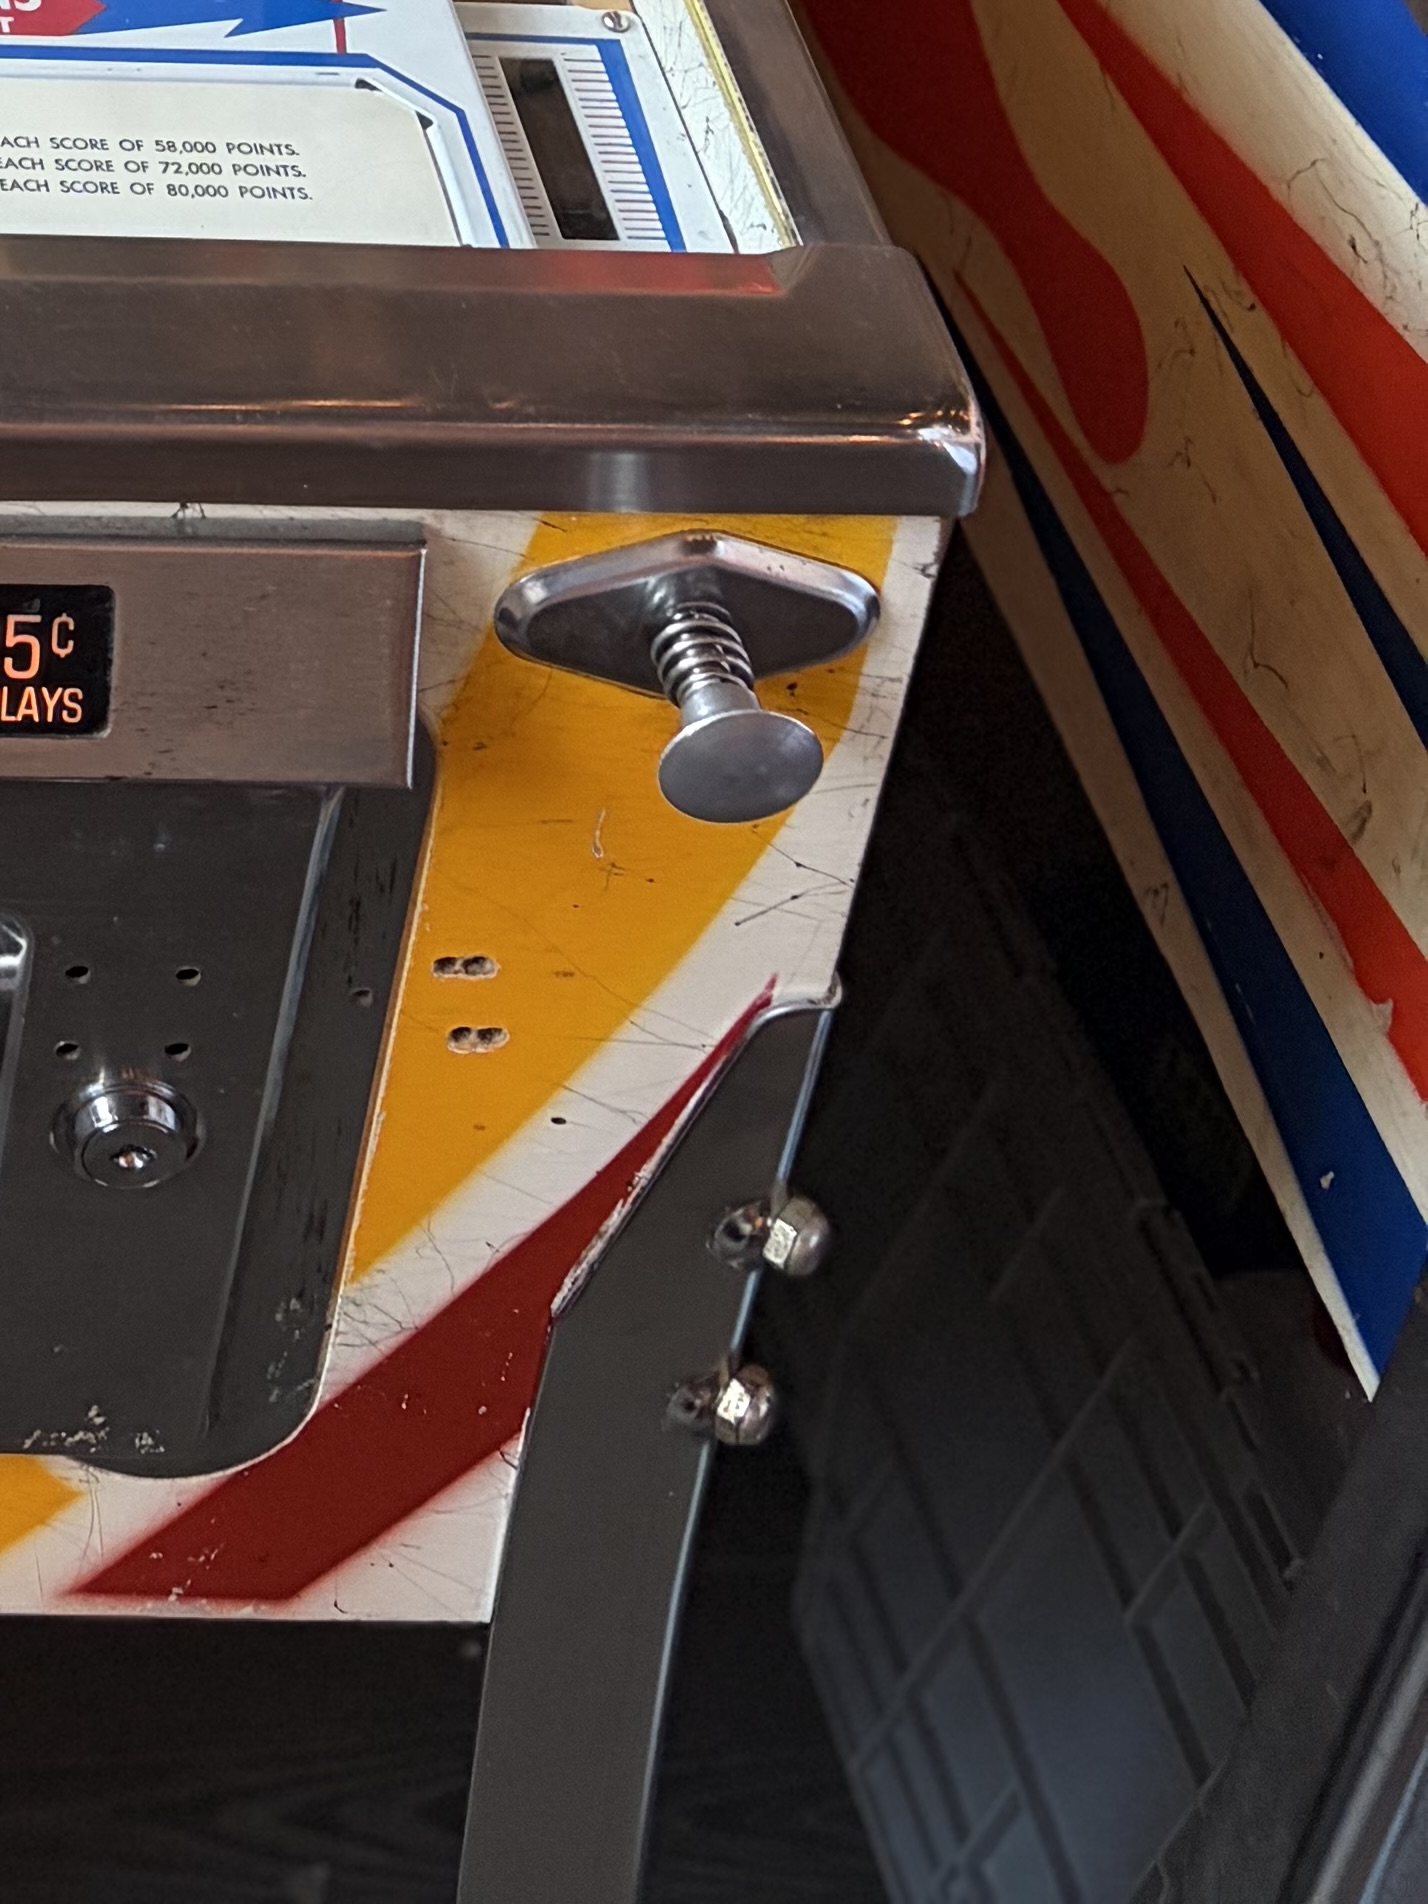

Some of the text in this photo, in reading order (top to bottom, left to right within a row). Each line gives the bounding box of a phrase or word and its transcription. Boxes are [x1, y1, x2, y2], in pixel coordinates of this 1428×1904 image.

[49, 137, 110, 151] SCORE
[119, 138, 145, 152] OF
[154, 139, 217, 155] 58,000
[226, 142, 301, 157] POINTS.
[54, 158, 115, 173] SCORE
[124, 159, 150, 174] OF
[158, 160, 223, 177] 72,000
[232, 163, 307, 179] POINTS.
[0, 179, 50, 193] EACH
[60, 181, 120, 195] SCORE
[129, 182, 155, 195] OF
[166, 183, 229, 199] 80,000
[239, 186, 314, 201] POINTS.
